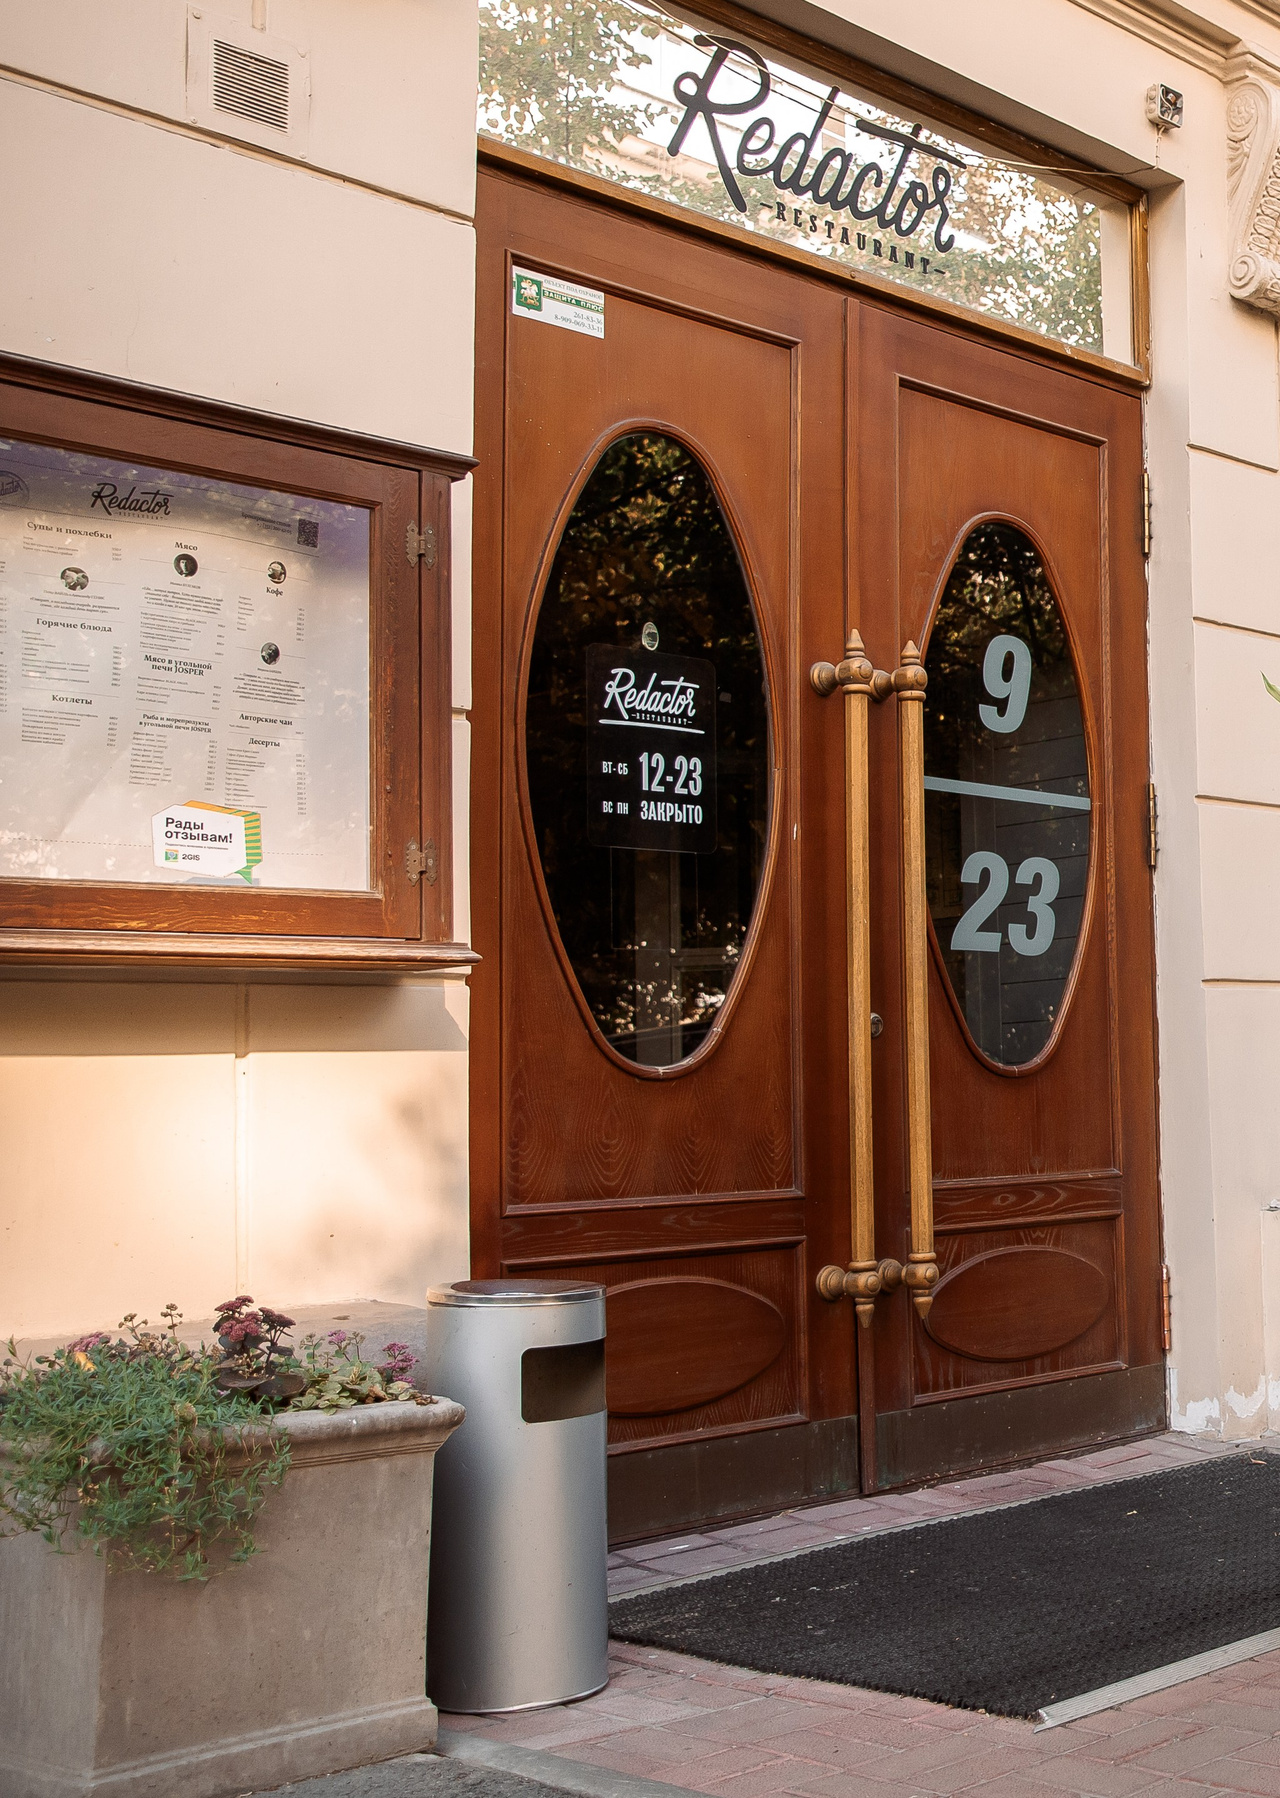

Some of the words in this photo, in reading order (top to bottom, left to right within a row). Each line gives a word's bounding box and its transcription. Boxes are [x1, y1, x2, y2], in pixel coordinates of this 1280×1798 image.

[667, 34, 967, 254] Redactor
[775, 201, 931, 275] RESTAURANT
[544, 290, 576, 304] ЗАЩИТА
[580, 301, 603, 312] ПЛЮС
[90, 482, 175, 516] Redactor
[26, 521, 53, 531] Супы
[65, 527, 112, 540] похлебки
[174, 541, 198, 551] Мясо
[266, 586, 284, 597] Кофе
[36, 617, 78, 629] Горячие
[80, 622, 113, 633] блюда
[143, 654, 166, 664] Мясо
[174, 660, 212, 670] угольной
[151, 663, 173, 672] печи
[174, 665, 205, 676] JOSPER
[978, 634, 1032, 734] 9
[52, 694, 93, 705] Котлеты
[604, 667, 700, 720] Redactor
[142, 713, 159, 721] Рыба
[166, 717, 210, 727] морепродукты
[239, 713, 279, 724] Авторские
[143, 721, 174, 730] угольной
[190, 725, 212, 734] JOSPER
[248, 737, 281, 748] Десерты
[638, 751, 702, 796] 12-23
[602, 800, 614, 814] ВС
[617, 801, 629, 815] ПН
[640, 799, 703, 825] ЗАКРЫТО
[165, 817, 204, 831] Рады
[164, 830, 233, 844] отзывам!
[181, 853, 201, 861] 2GIS
[950, 850, 1060, 957] 23
